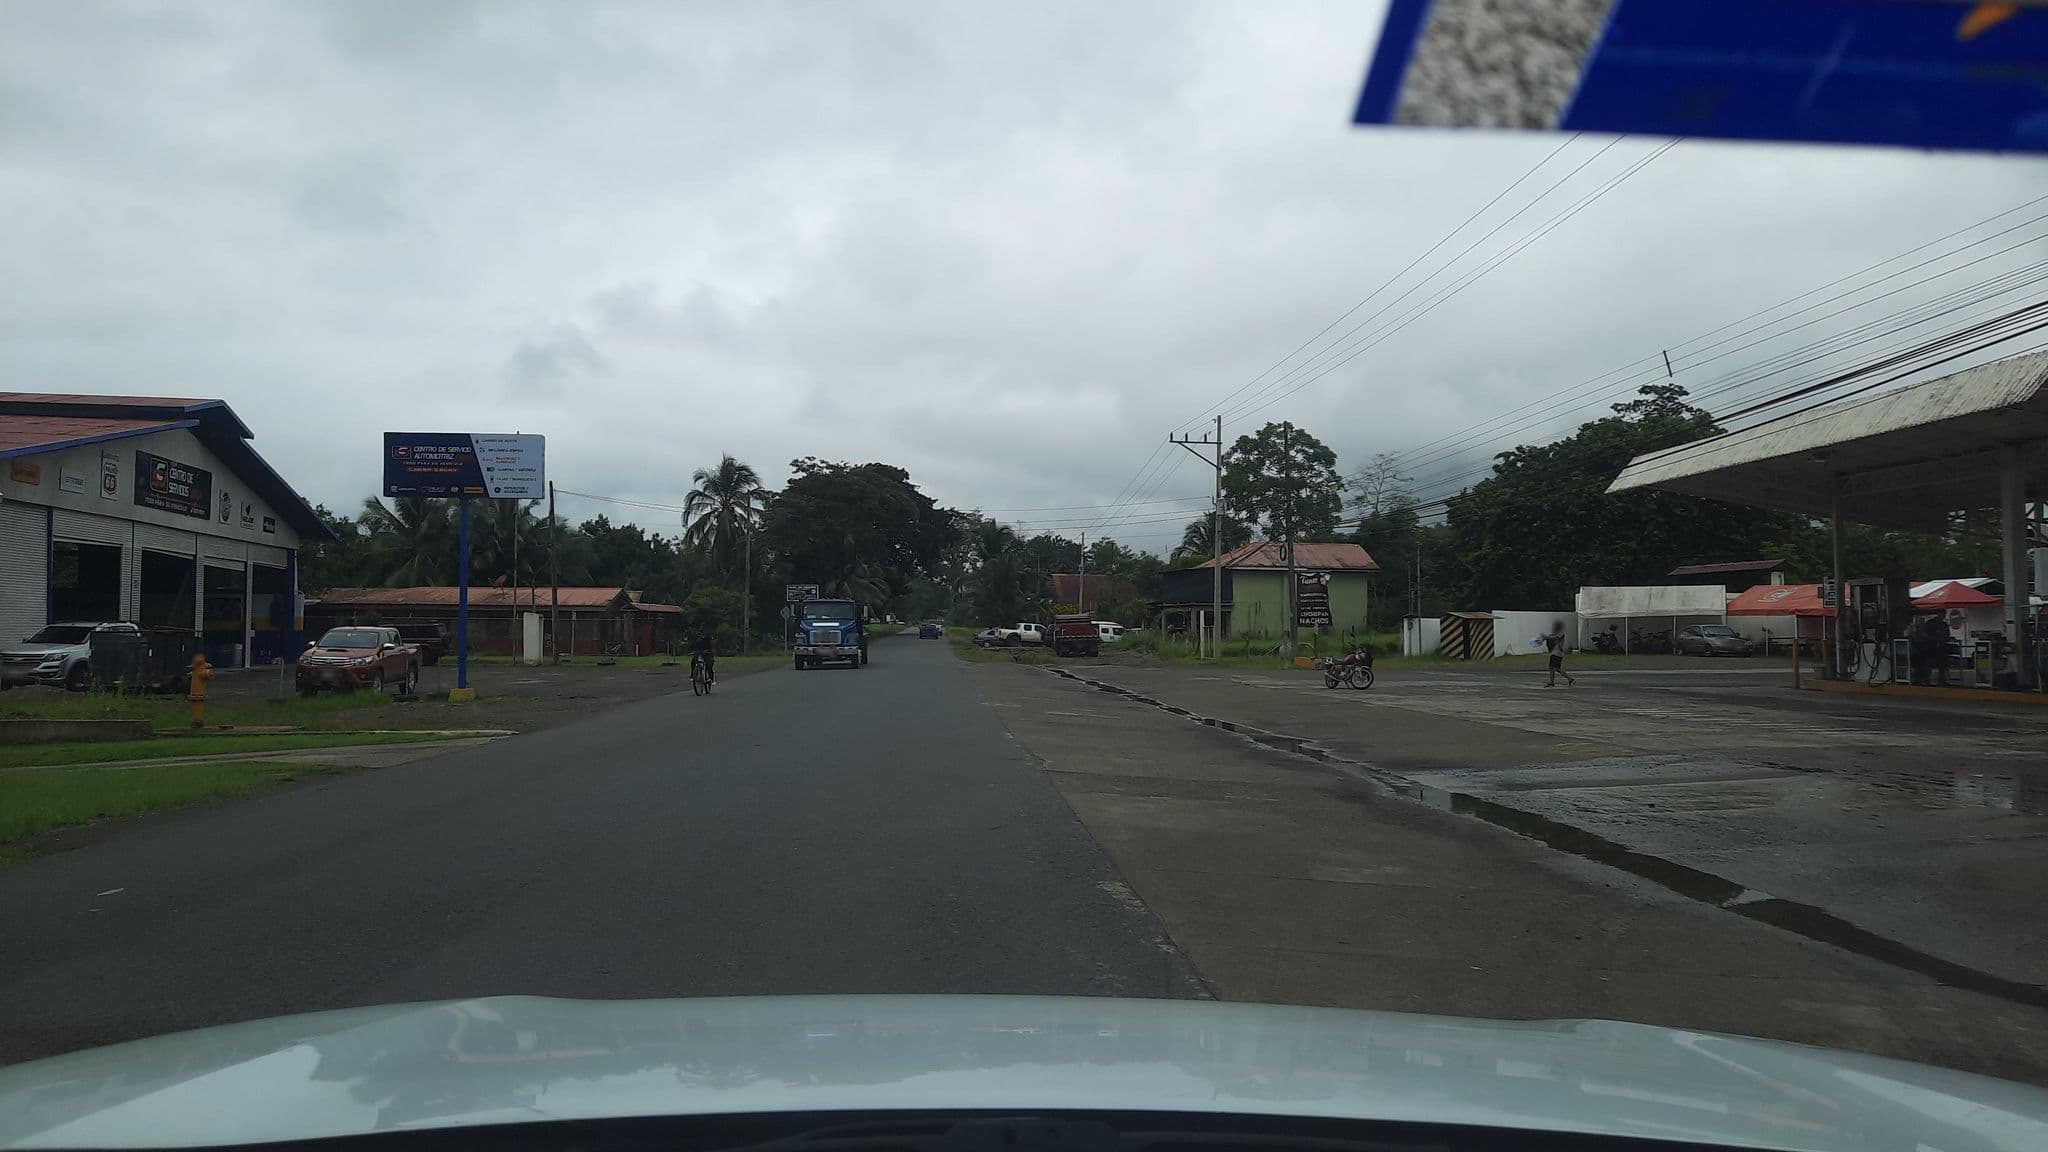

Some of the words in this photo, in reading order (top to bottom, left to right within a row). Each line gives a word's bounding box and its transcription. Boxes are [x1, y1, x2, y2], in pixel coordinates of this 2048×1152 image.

[447, 446, 472, 454] SERVICIO
[105, 475, 114, 490] 66
[169, 467, 187, 482] CENTRO
[187, 472, 194, 484] DE
